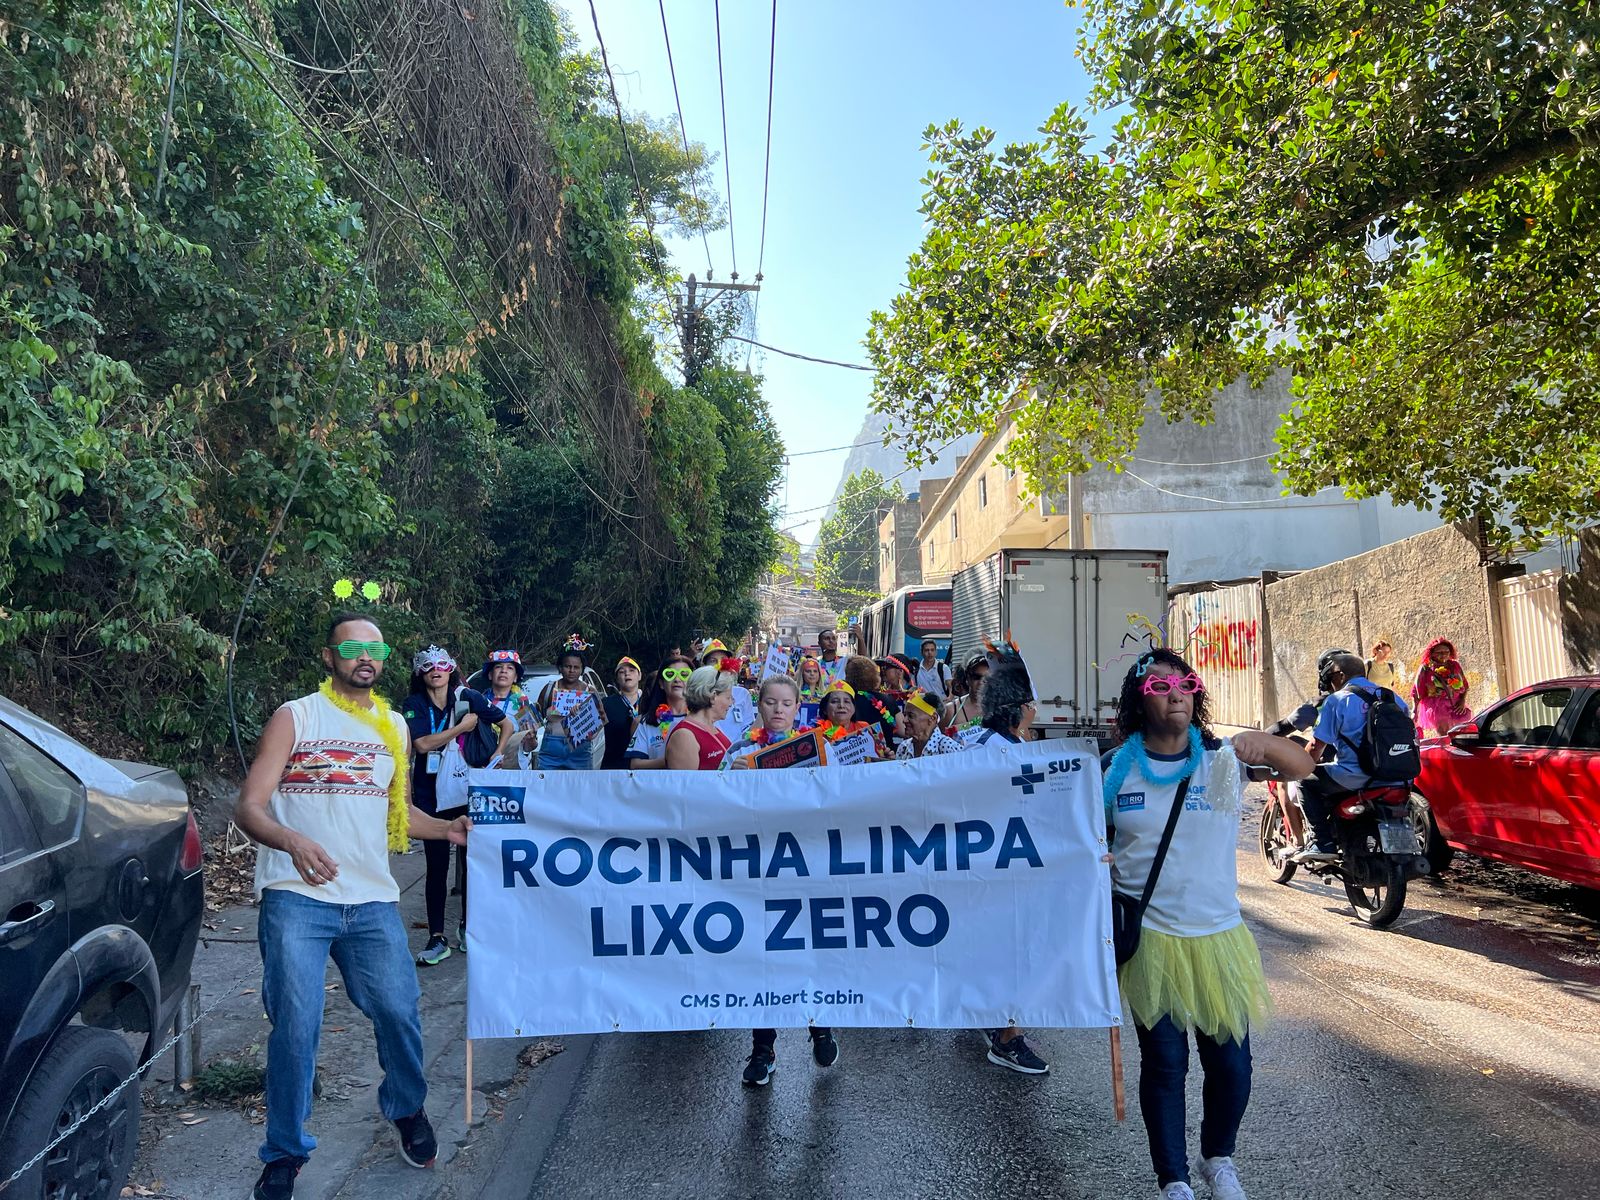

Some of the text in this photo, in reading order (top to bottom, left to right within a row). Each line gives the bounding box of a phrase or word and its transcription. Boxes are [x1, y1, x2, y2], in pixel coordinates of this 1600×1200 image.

[1083, 730, 1106, 738] PEDRO
[1392, 743, 1410, 751] NIKE
[1048, 757, 1081, 775] SUS
[488, 796, 520, 813] Rio
[1129, 795, 1143, 803] RIO
[501, 816, 1044, 888] ROCINHA LIMPA
[590, 893, 950, 957] LIXO ZERO
[680, 989, 864, 1008] CMS Dr. Albert Sabin
